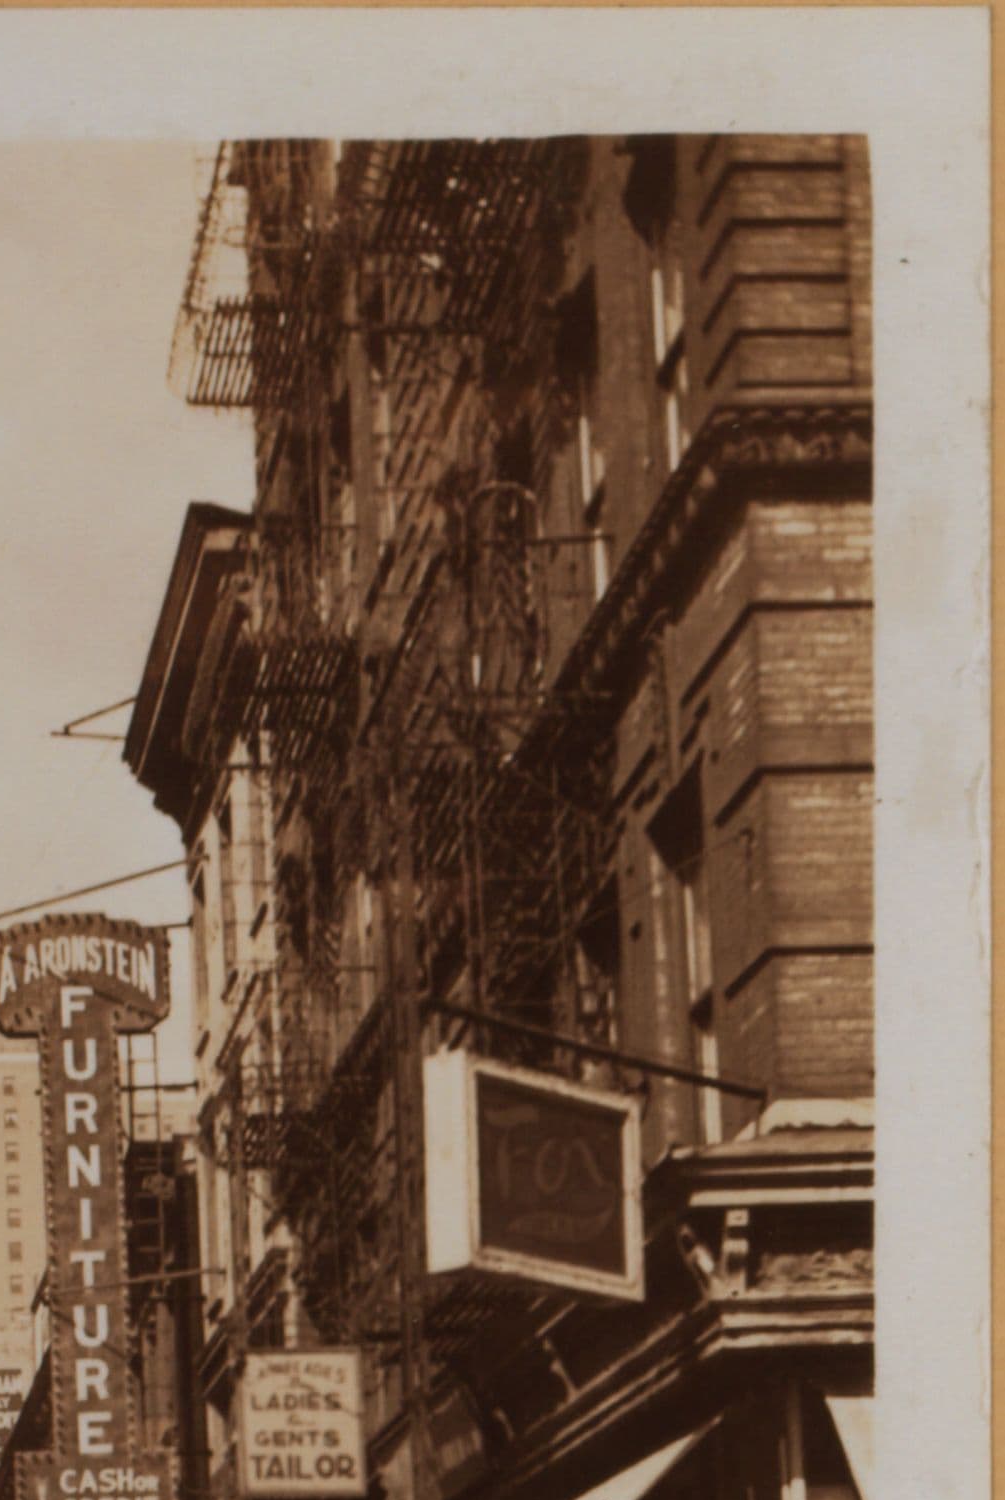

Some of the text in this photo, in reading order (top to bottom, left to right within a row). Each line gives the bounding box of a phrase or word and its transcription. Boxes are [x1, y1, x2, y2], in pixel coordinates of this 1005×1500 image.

[24, 935, 156, 1001] ARONSTEIN
[60, 985, 113, 1455] FURNITURE
[250, 1392, 342, 1412] LADIES
[254, 1429, 342, 1448] GENTS
[58, 1467, 134, 1494] CASH
[250, 1453, 356, 1481] TAILOR
